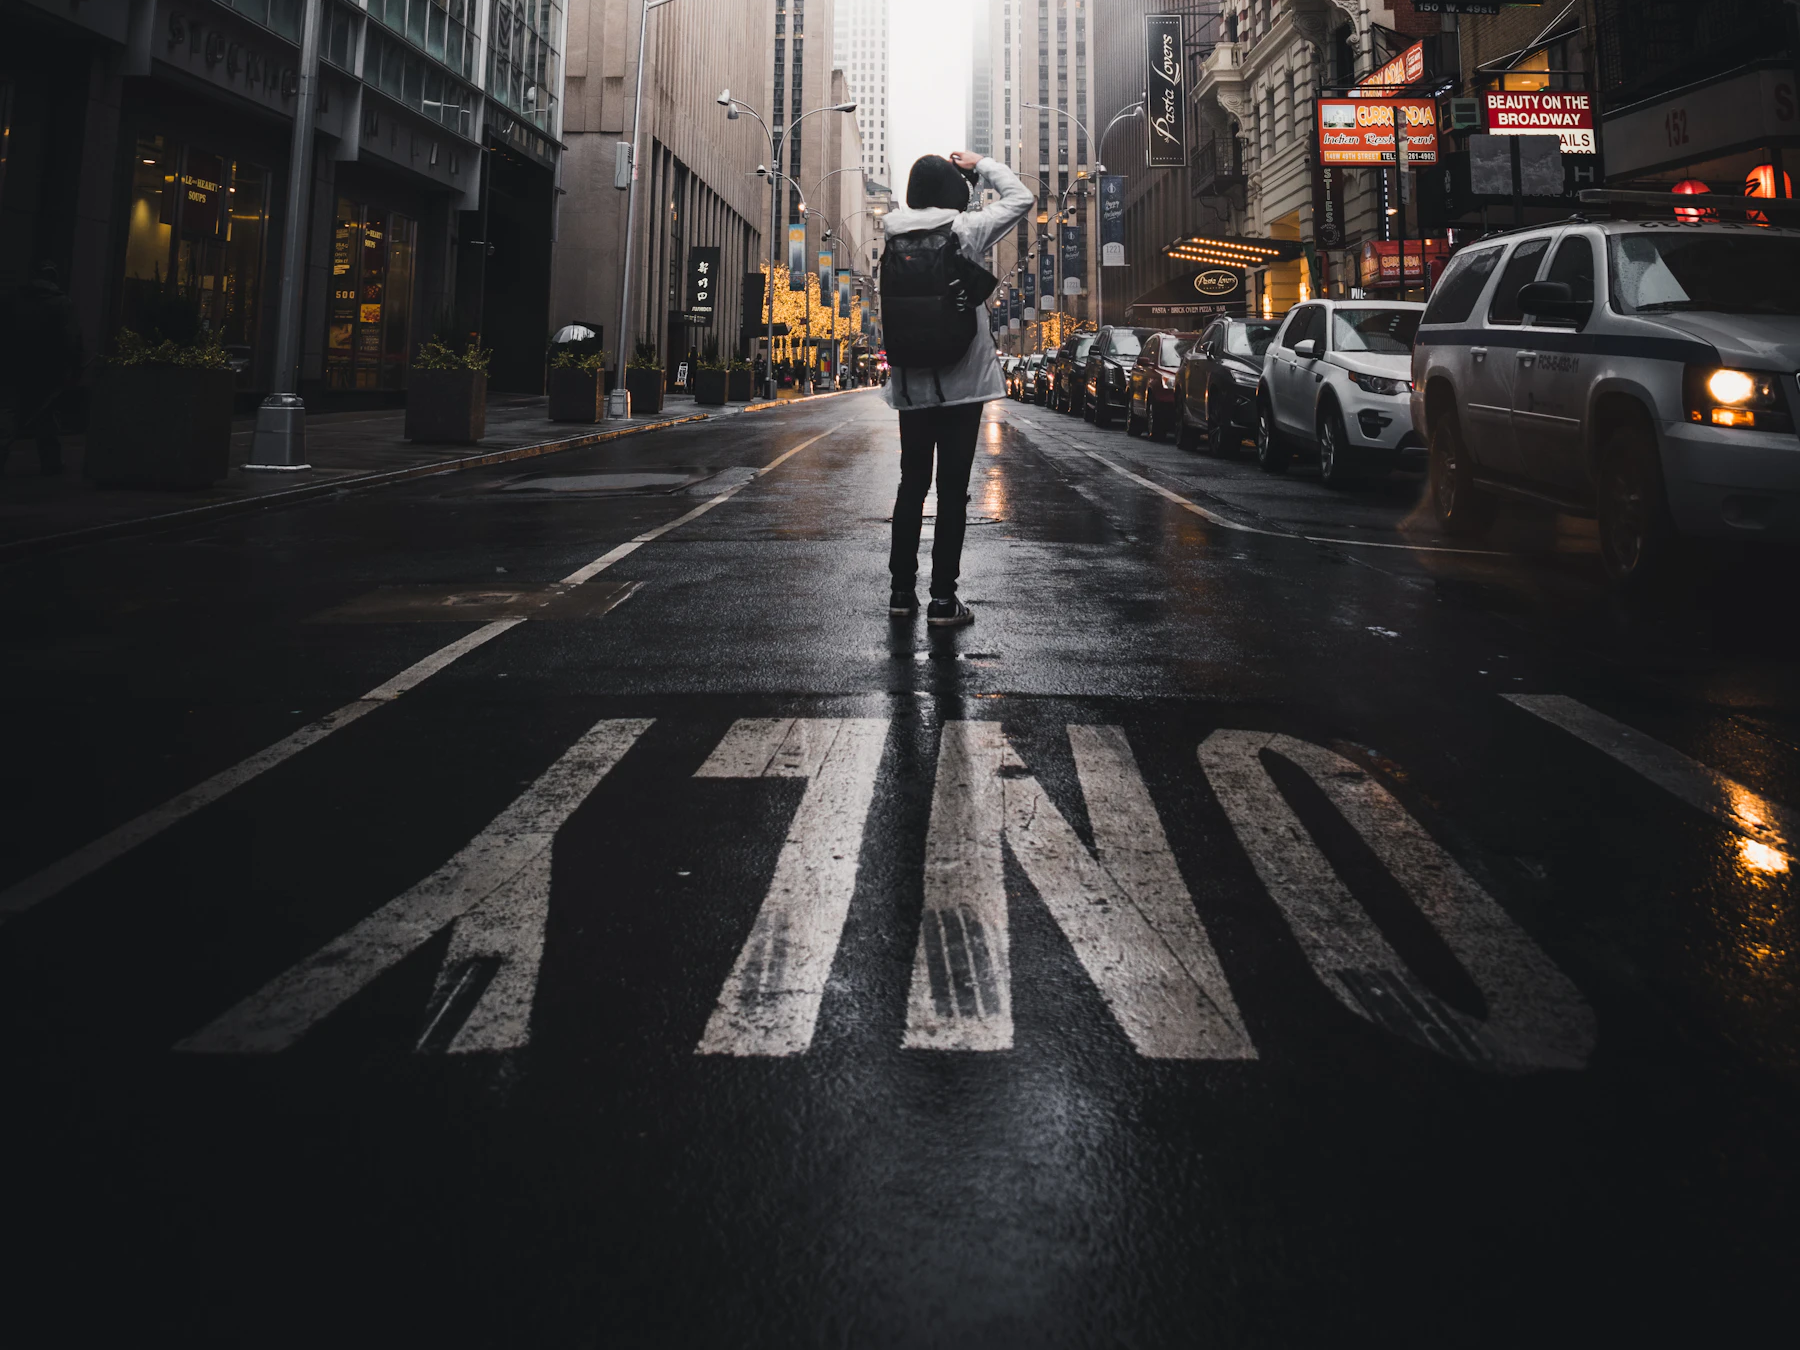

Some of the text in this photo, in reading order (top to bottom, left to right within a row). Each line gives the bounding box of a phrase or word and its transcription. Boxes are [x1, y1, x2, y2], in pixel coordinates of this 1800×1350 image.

[1419, 3, 1439, 12] 150
[1446, 4, 1460, 13] W.
[1151, 33, 1181, 87] Lovers
[1487, 95, 1589, 109] BEAUTY ON THE
[1151, 88, 1181, 146] Pasta
[1400, 105, 1434, 127] NDIA
[1497, 113, 1580, 126] BROADWAY
[1665, 109, 1689, 147] 152
[1323, 133, 1360, 145] Indian
[1560, 134, 1590, 147] AILS
[1358, 152, 1379, 160] STREET
[188, 190, 207, 204] SOUPS
[1106, 245, 1121, 254] 1221
[1197, 274, 1237, 287] Pasta Lovers
[172, 716, 1597, 1074] ONLY
